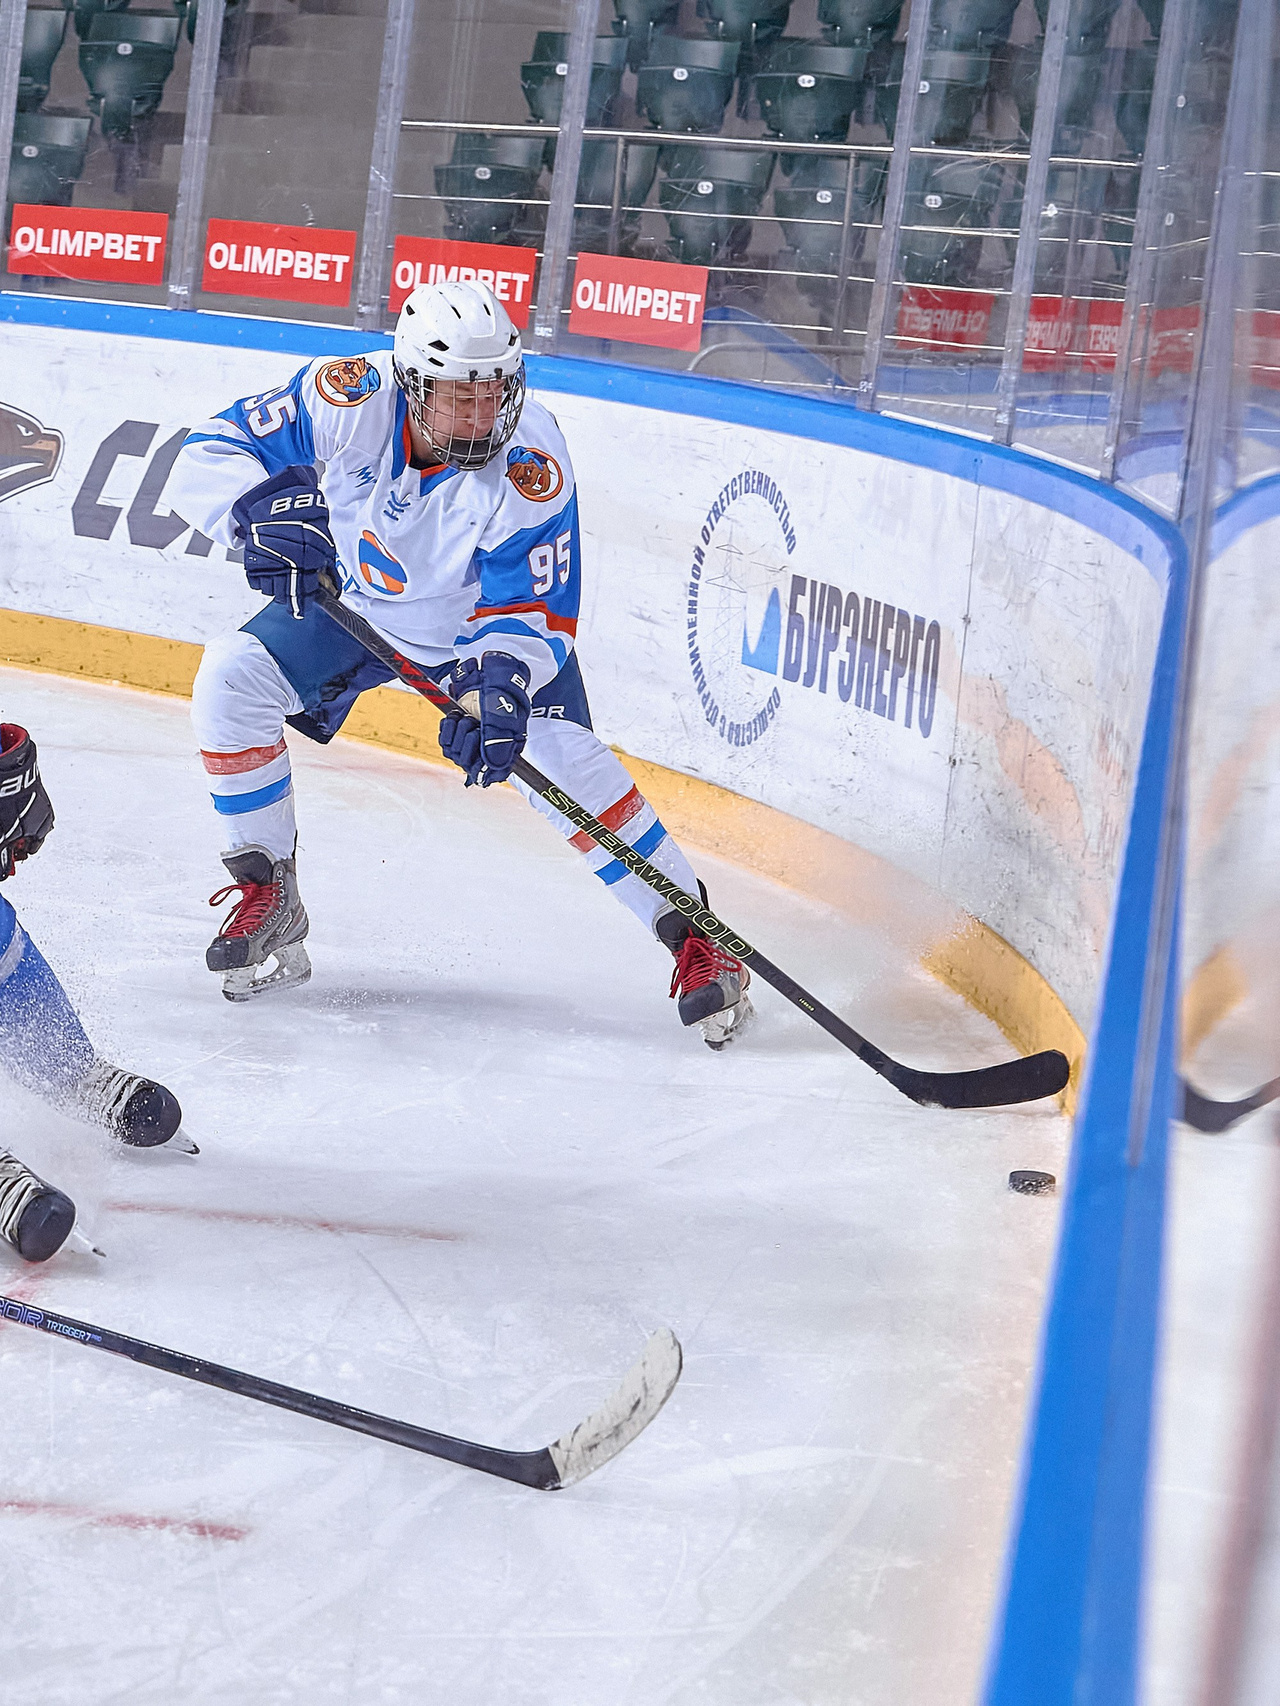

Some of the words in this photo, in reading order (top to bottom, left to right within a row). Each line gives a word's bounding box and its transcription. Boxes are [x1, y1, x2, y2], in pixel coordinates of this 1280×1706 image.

[15, 226, 162, 262] OLIMPBET
[208, 242, 350, 282] OLIMPBET
[576, 279, 701, 324] OLIMPBET
[701, 470, 797, 555] ОТВЕТСТВЕННОСТЬЮ
[528, 530, 571, 596] 95
[782, 574, 941, 739] БУРЭНЕРГО
[540, 785, 755, 959] SHERWOOD
